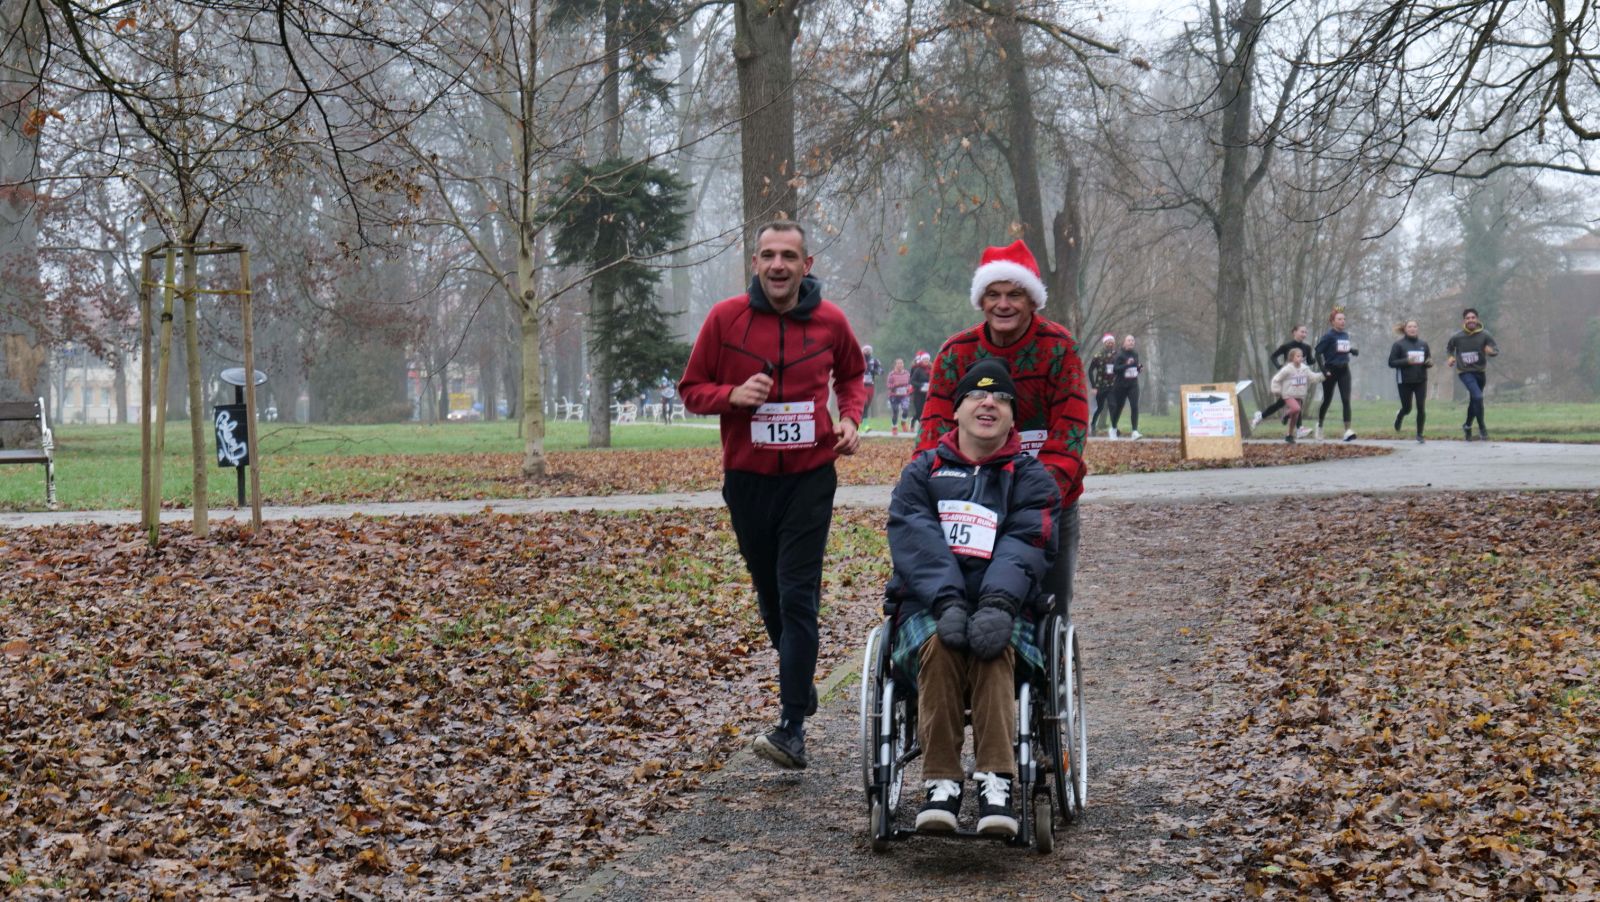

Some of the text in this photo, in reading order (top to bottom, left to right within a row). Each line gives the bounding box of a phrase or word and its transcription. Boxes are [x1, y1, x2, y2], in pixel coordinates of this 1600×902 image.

[768, 422, 800, 442] 153
[951, 514, 976, 524] ADVENT
[977, 518, 992, 526] RUN
[949, 523, 972, 545] 45
